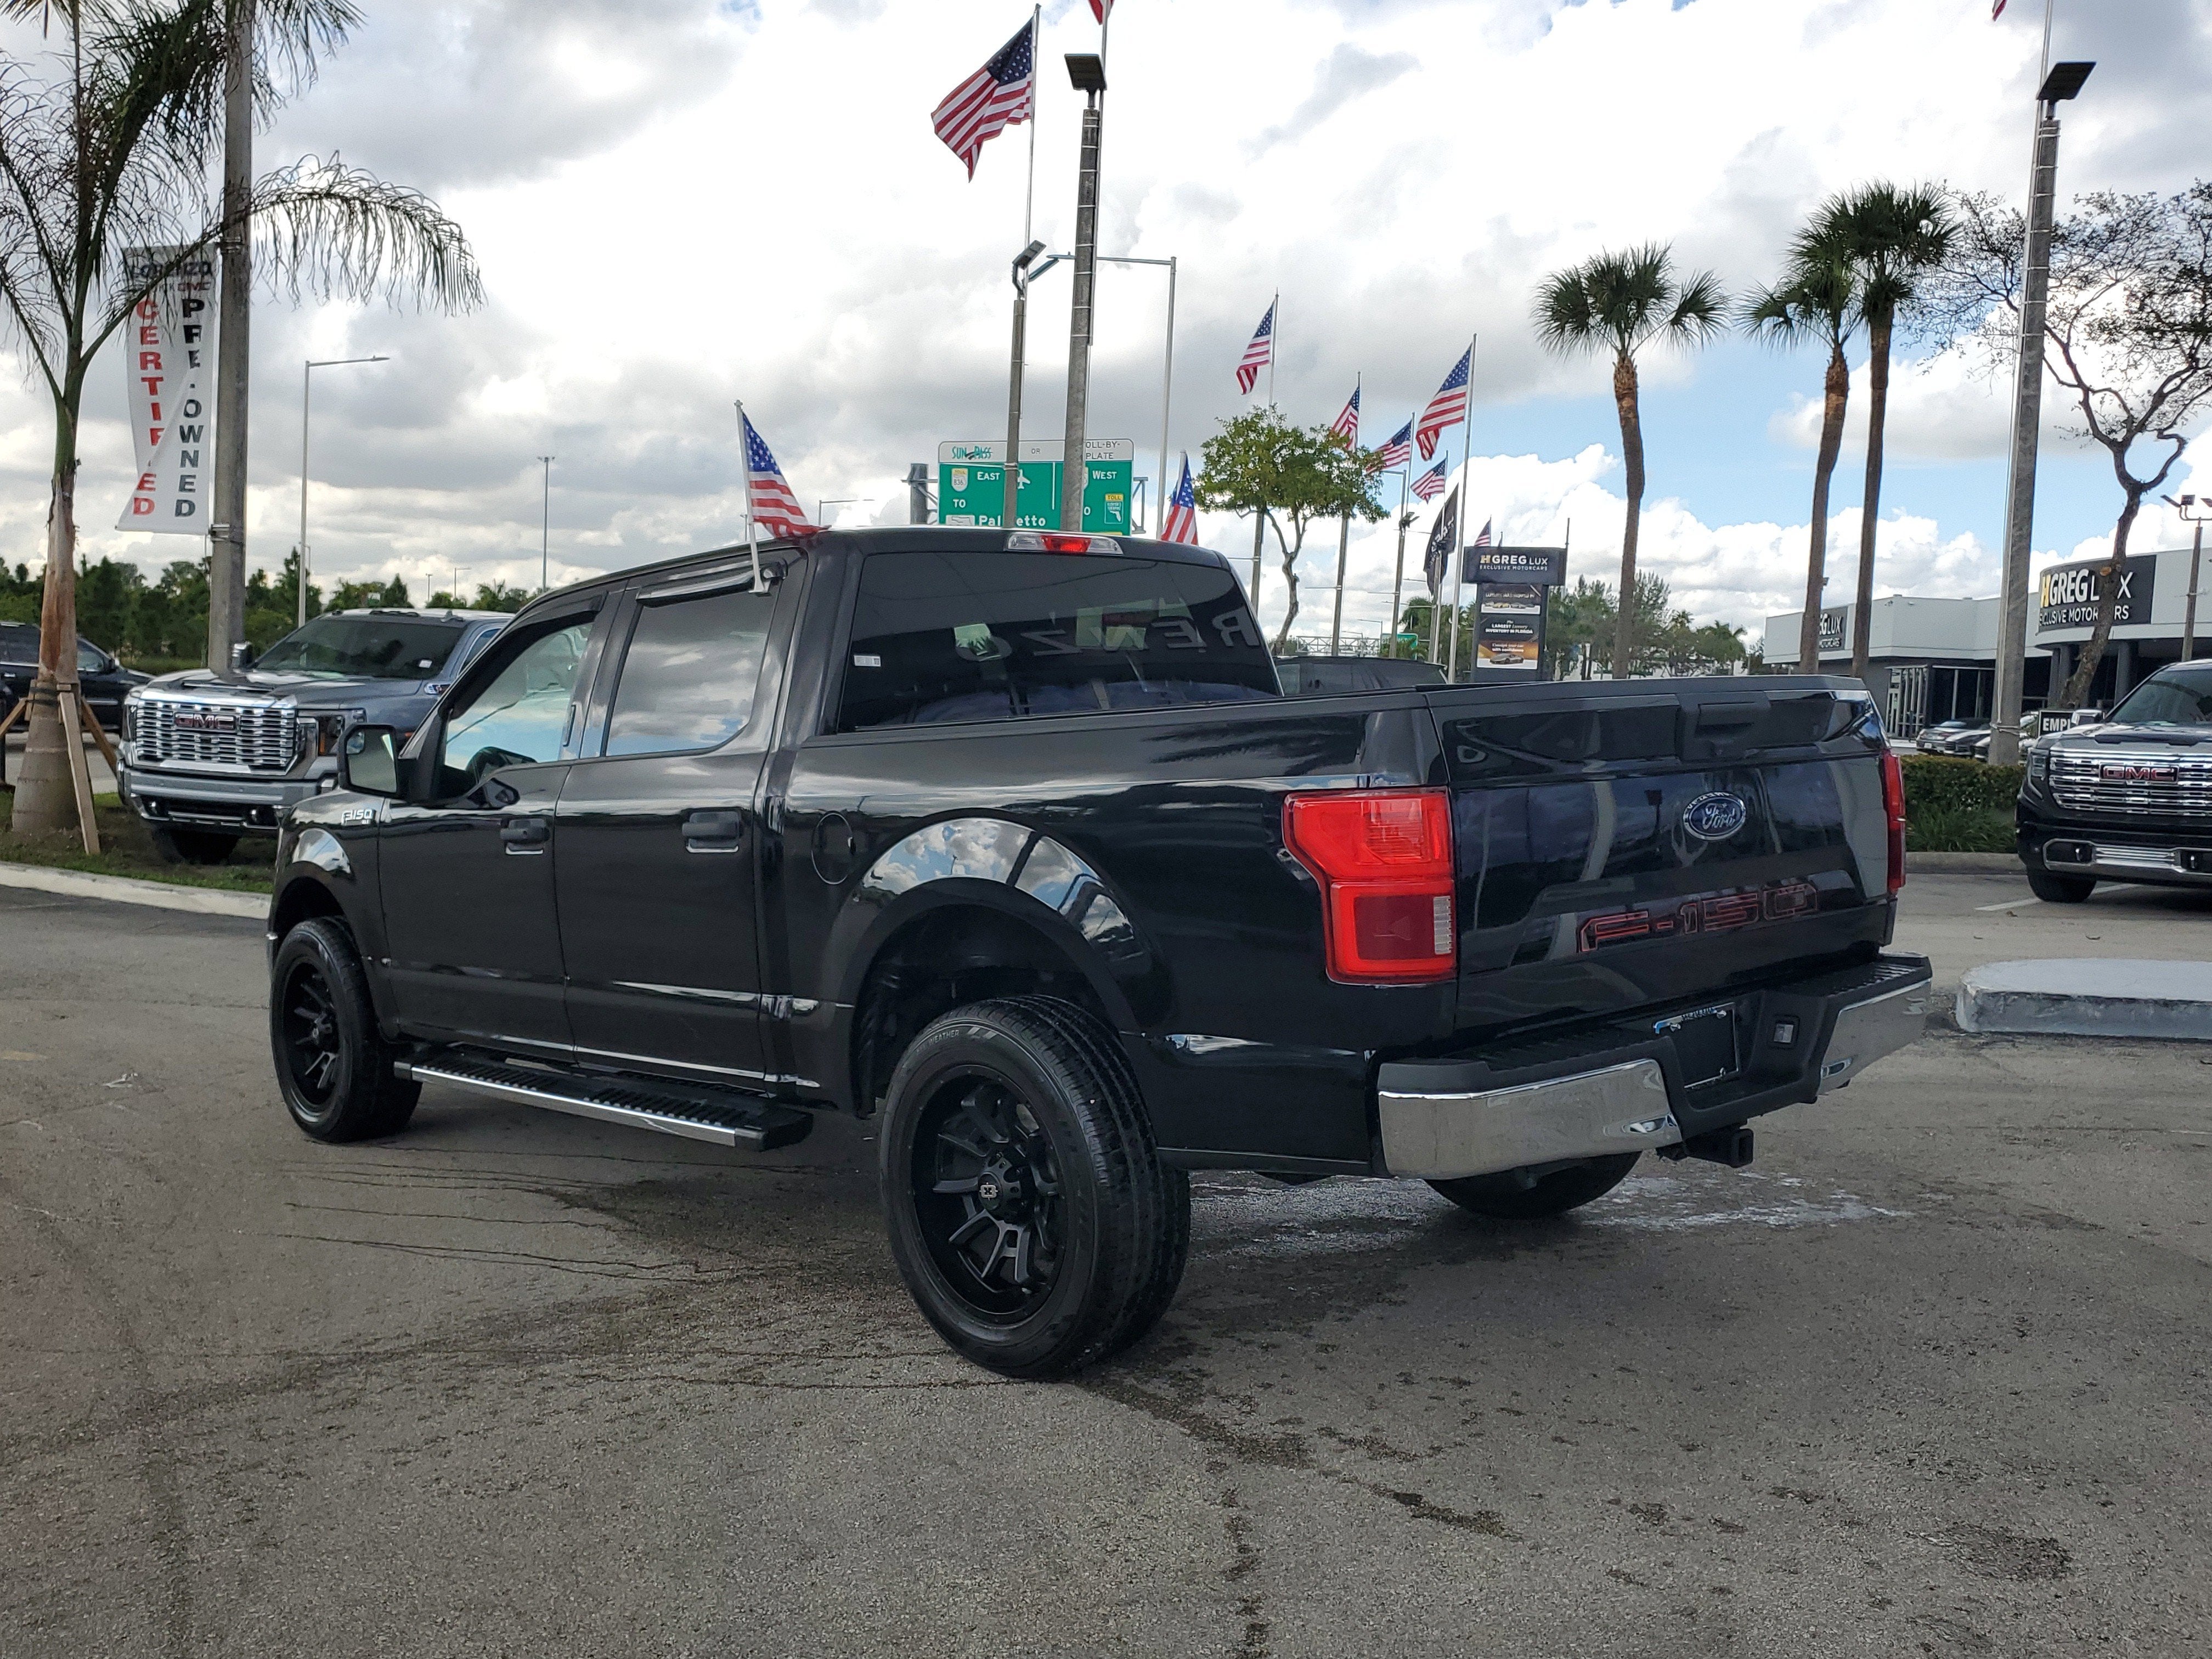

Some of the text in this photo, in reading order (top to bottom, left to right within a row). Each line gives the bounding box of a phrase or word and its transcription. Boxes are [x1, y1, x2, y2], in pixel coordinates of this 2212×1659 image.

[133, 300, 165, 516] CERTIFED
[977, 471, 1000, 481] EAST
[1092, 471, 1117, 479] WEST
[953, 499, 966, 508] TO
[1084, 507, 1091, 515] O
[979, 515, 1046, 527] Paletto
[1480, 555, 1527, 565] HGREG
[2090, 572, 2133, 601] LX
[2069, 605, 2129, 622] MOTORRS
[175, 713, 235, 729] GMC
[2103, 766, 2175, 782] GMC
[1702, 803, 1736, 830] Ford
[1579, 883, 1819, 953] F-150
